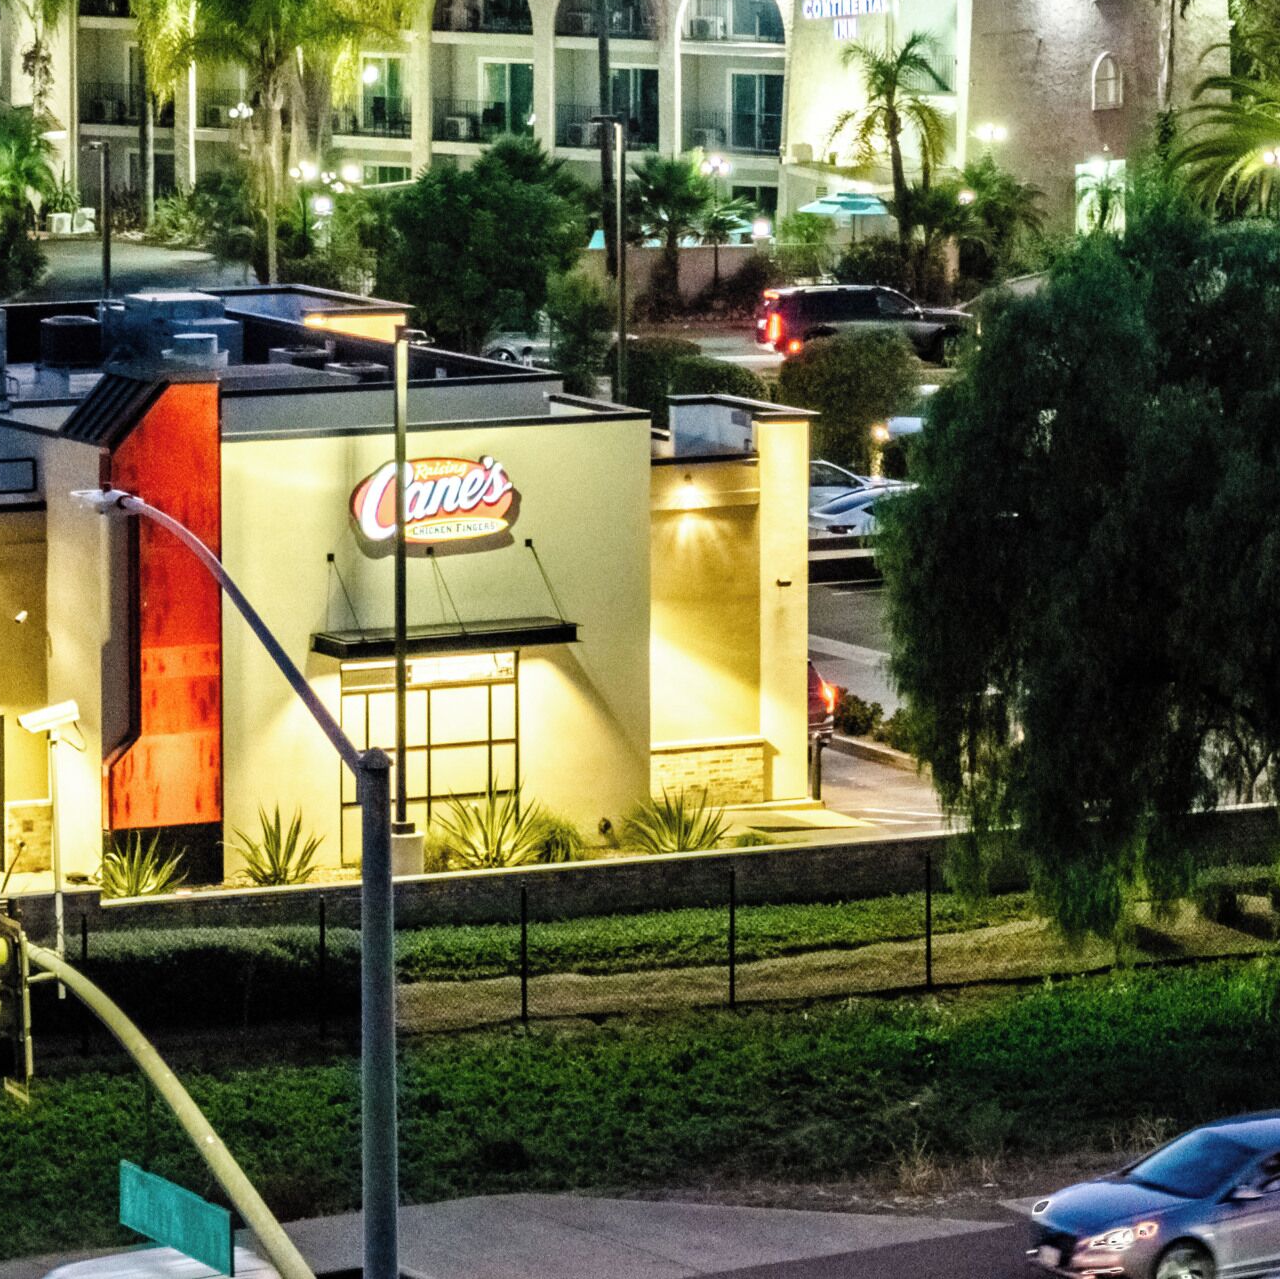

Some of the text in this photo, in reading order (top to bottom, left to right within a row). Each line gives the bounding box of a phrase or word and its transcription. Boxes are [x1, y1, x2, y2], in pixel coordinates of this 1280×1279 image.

[833, 17, 858, 40] INN
[414, 460, 468, 481] Raising
[360, 455, 513, 541] Cane's
[411, 521, 496, 536] CHICKEN FINGERS
